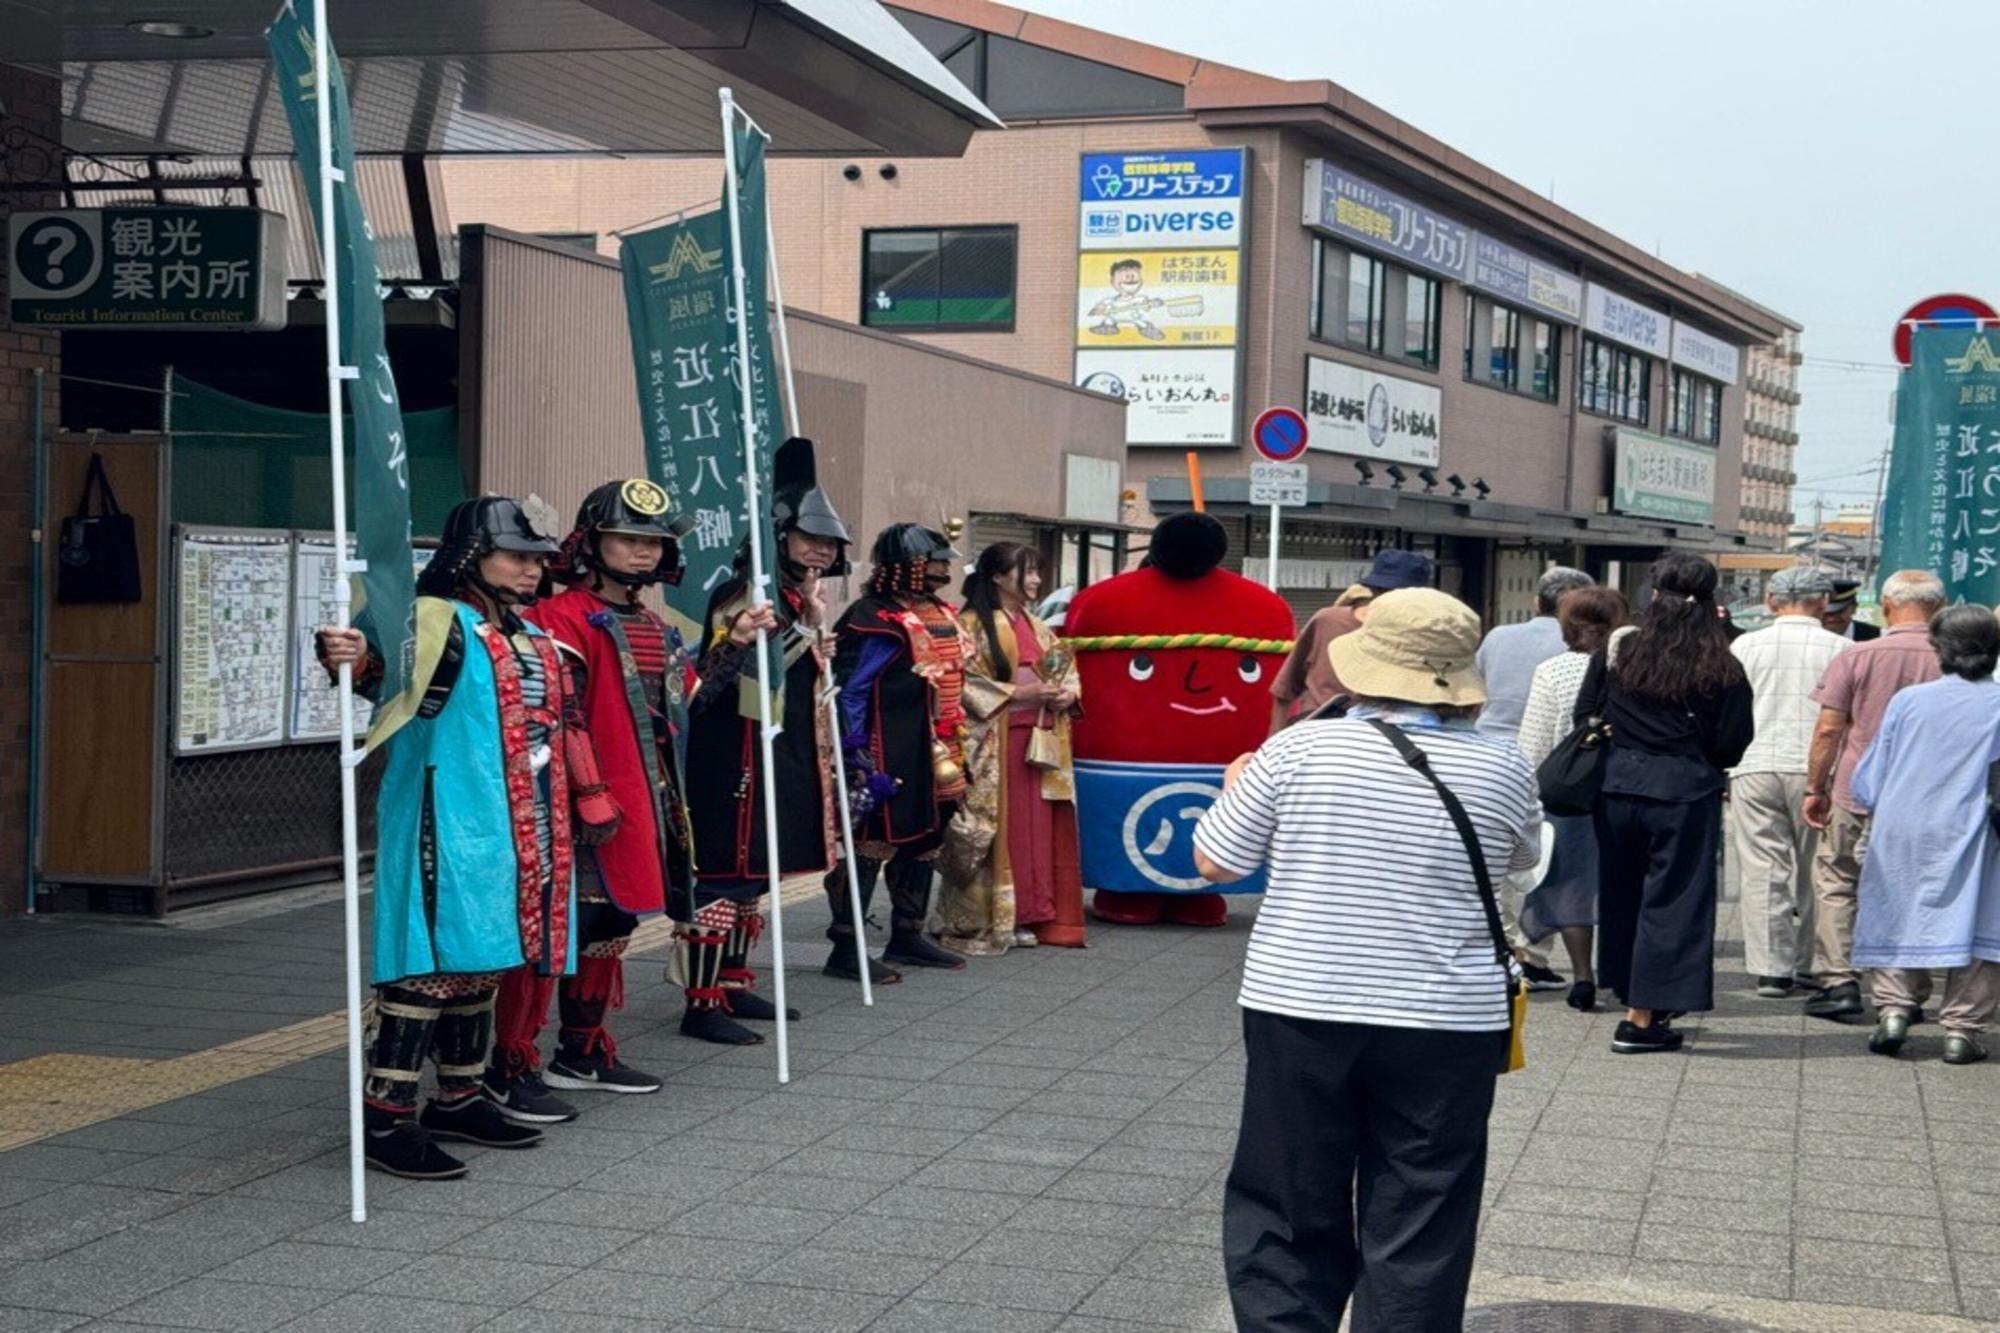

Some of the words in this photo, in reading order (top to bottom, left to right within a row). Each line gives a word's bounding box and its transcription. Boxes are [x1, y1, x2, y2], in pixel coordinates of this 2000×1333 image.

[1122, 174, 1233, 197] フリーステップ
[111, 217, 202, 256] 観光
[1162, 256, 1226, 269] はちまん
[112, 259, 249, 300] 案内所
[33, 309, 86, 322] Tourist
[93, 308, 186, 322] Information
[190, 308, 243, 322] Center
[1128, 387, 1220, 402] らいおん丸
[1255, 489, 1302, 501] ここまで
